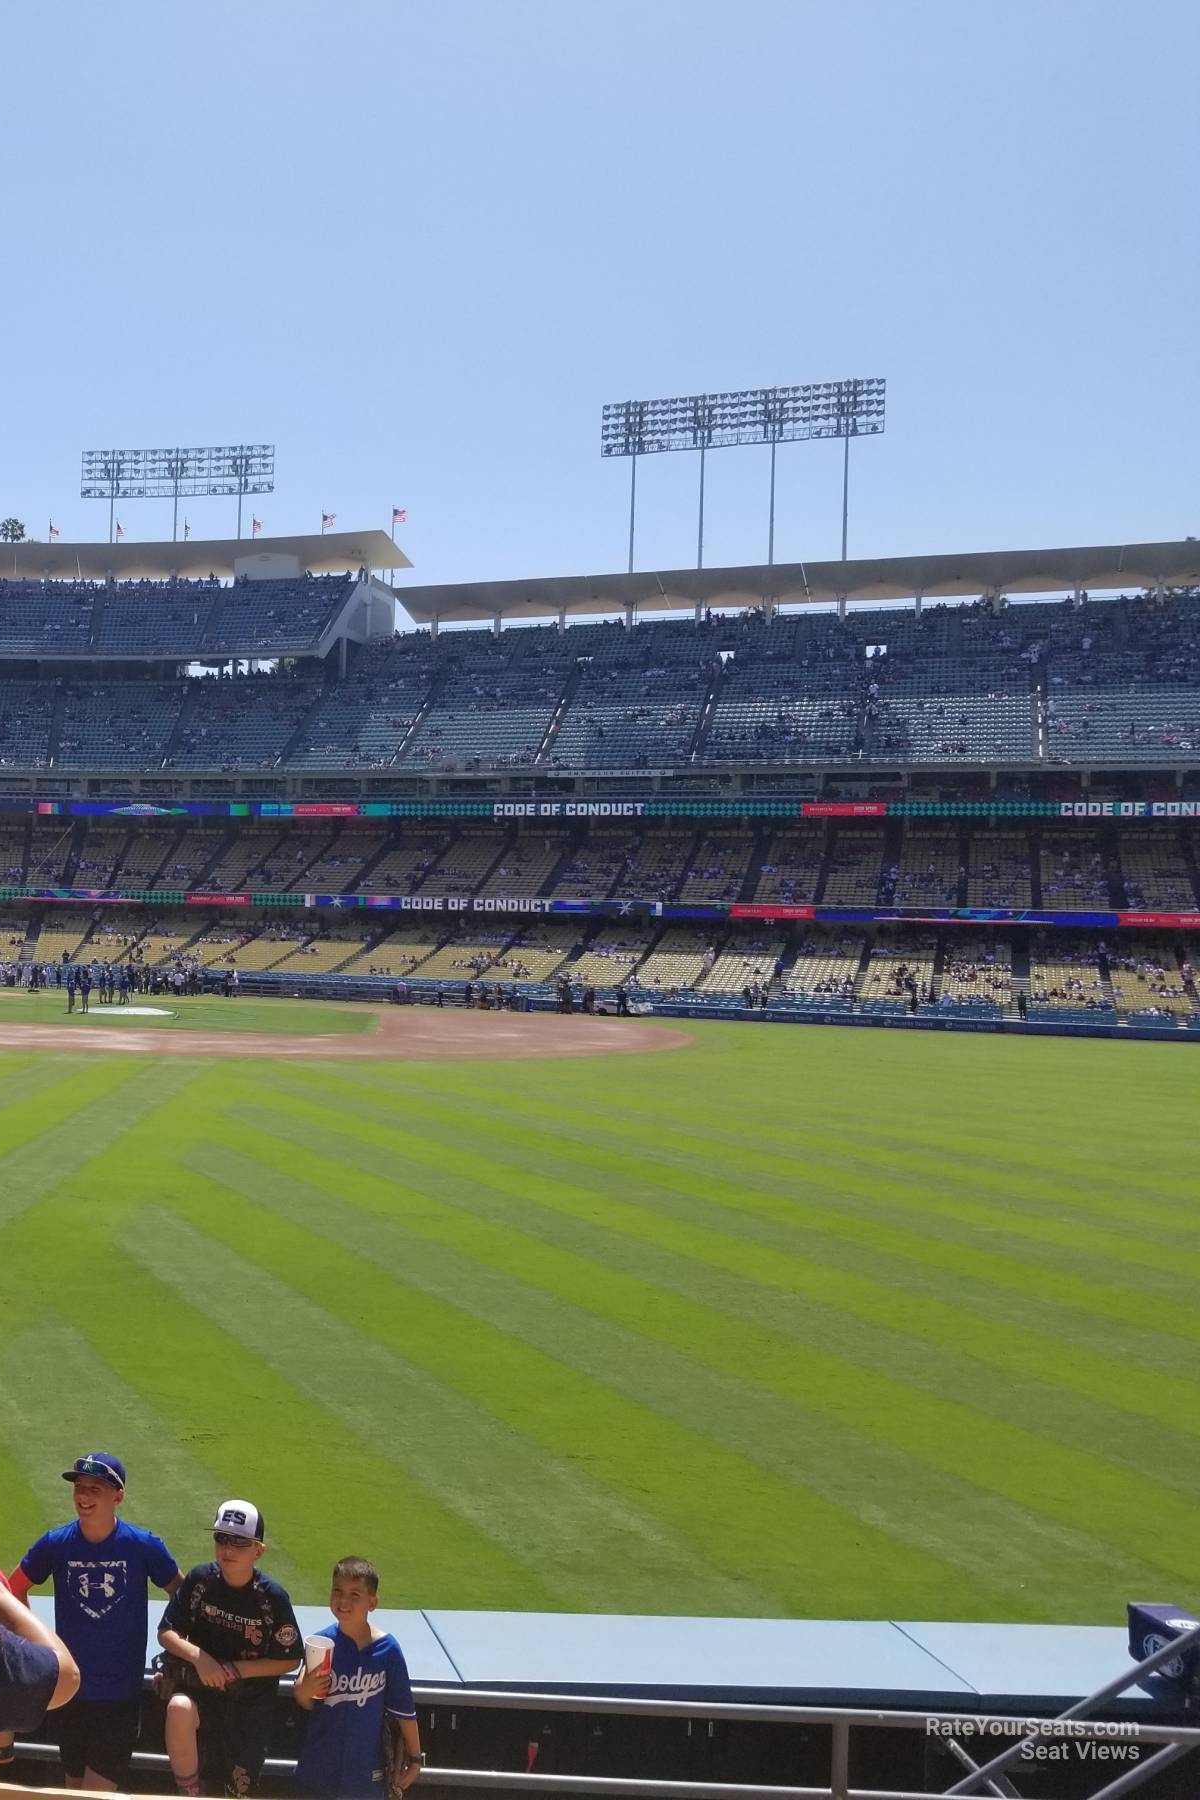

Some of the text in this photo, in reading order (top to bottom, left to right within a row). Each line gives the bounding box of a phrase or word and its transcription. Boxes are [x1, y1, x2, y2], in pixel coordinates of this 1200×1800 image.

[493, 803, 645, 816] CODE OF CONDUCT
[1060, 802, 1114, 816] CODE
[1120, 802, 1146, 816] OF
[401, 897, 552, 913] CODE OF CONDUCT
[222, 1509, 247, 1526] ES
[216, 1608, 262, 1626] FIVE CITIES
